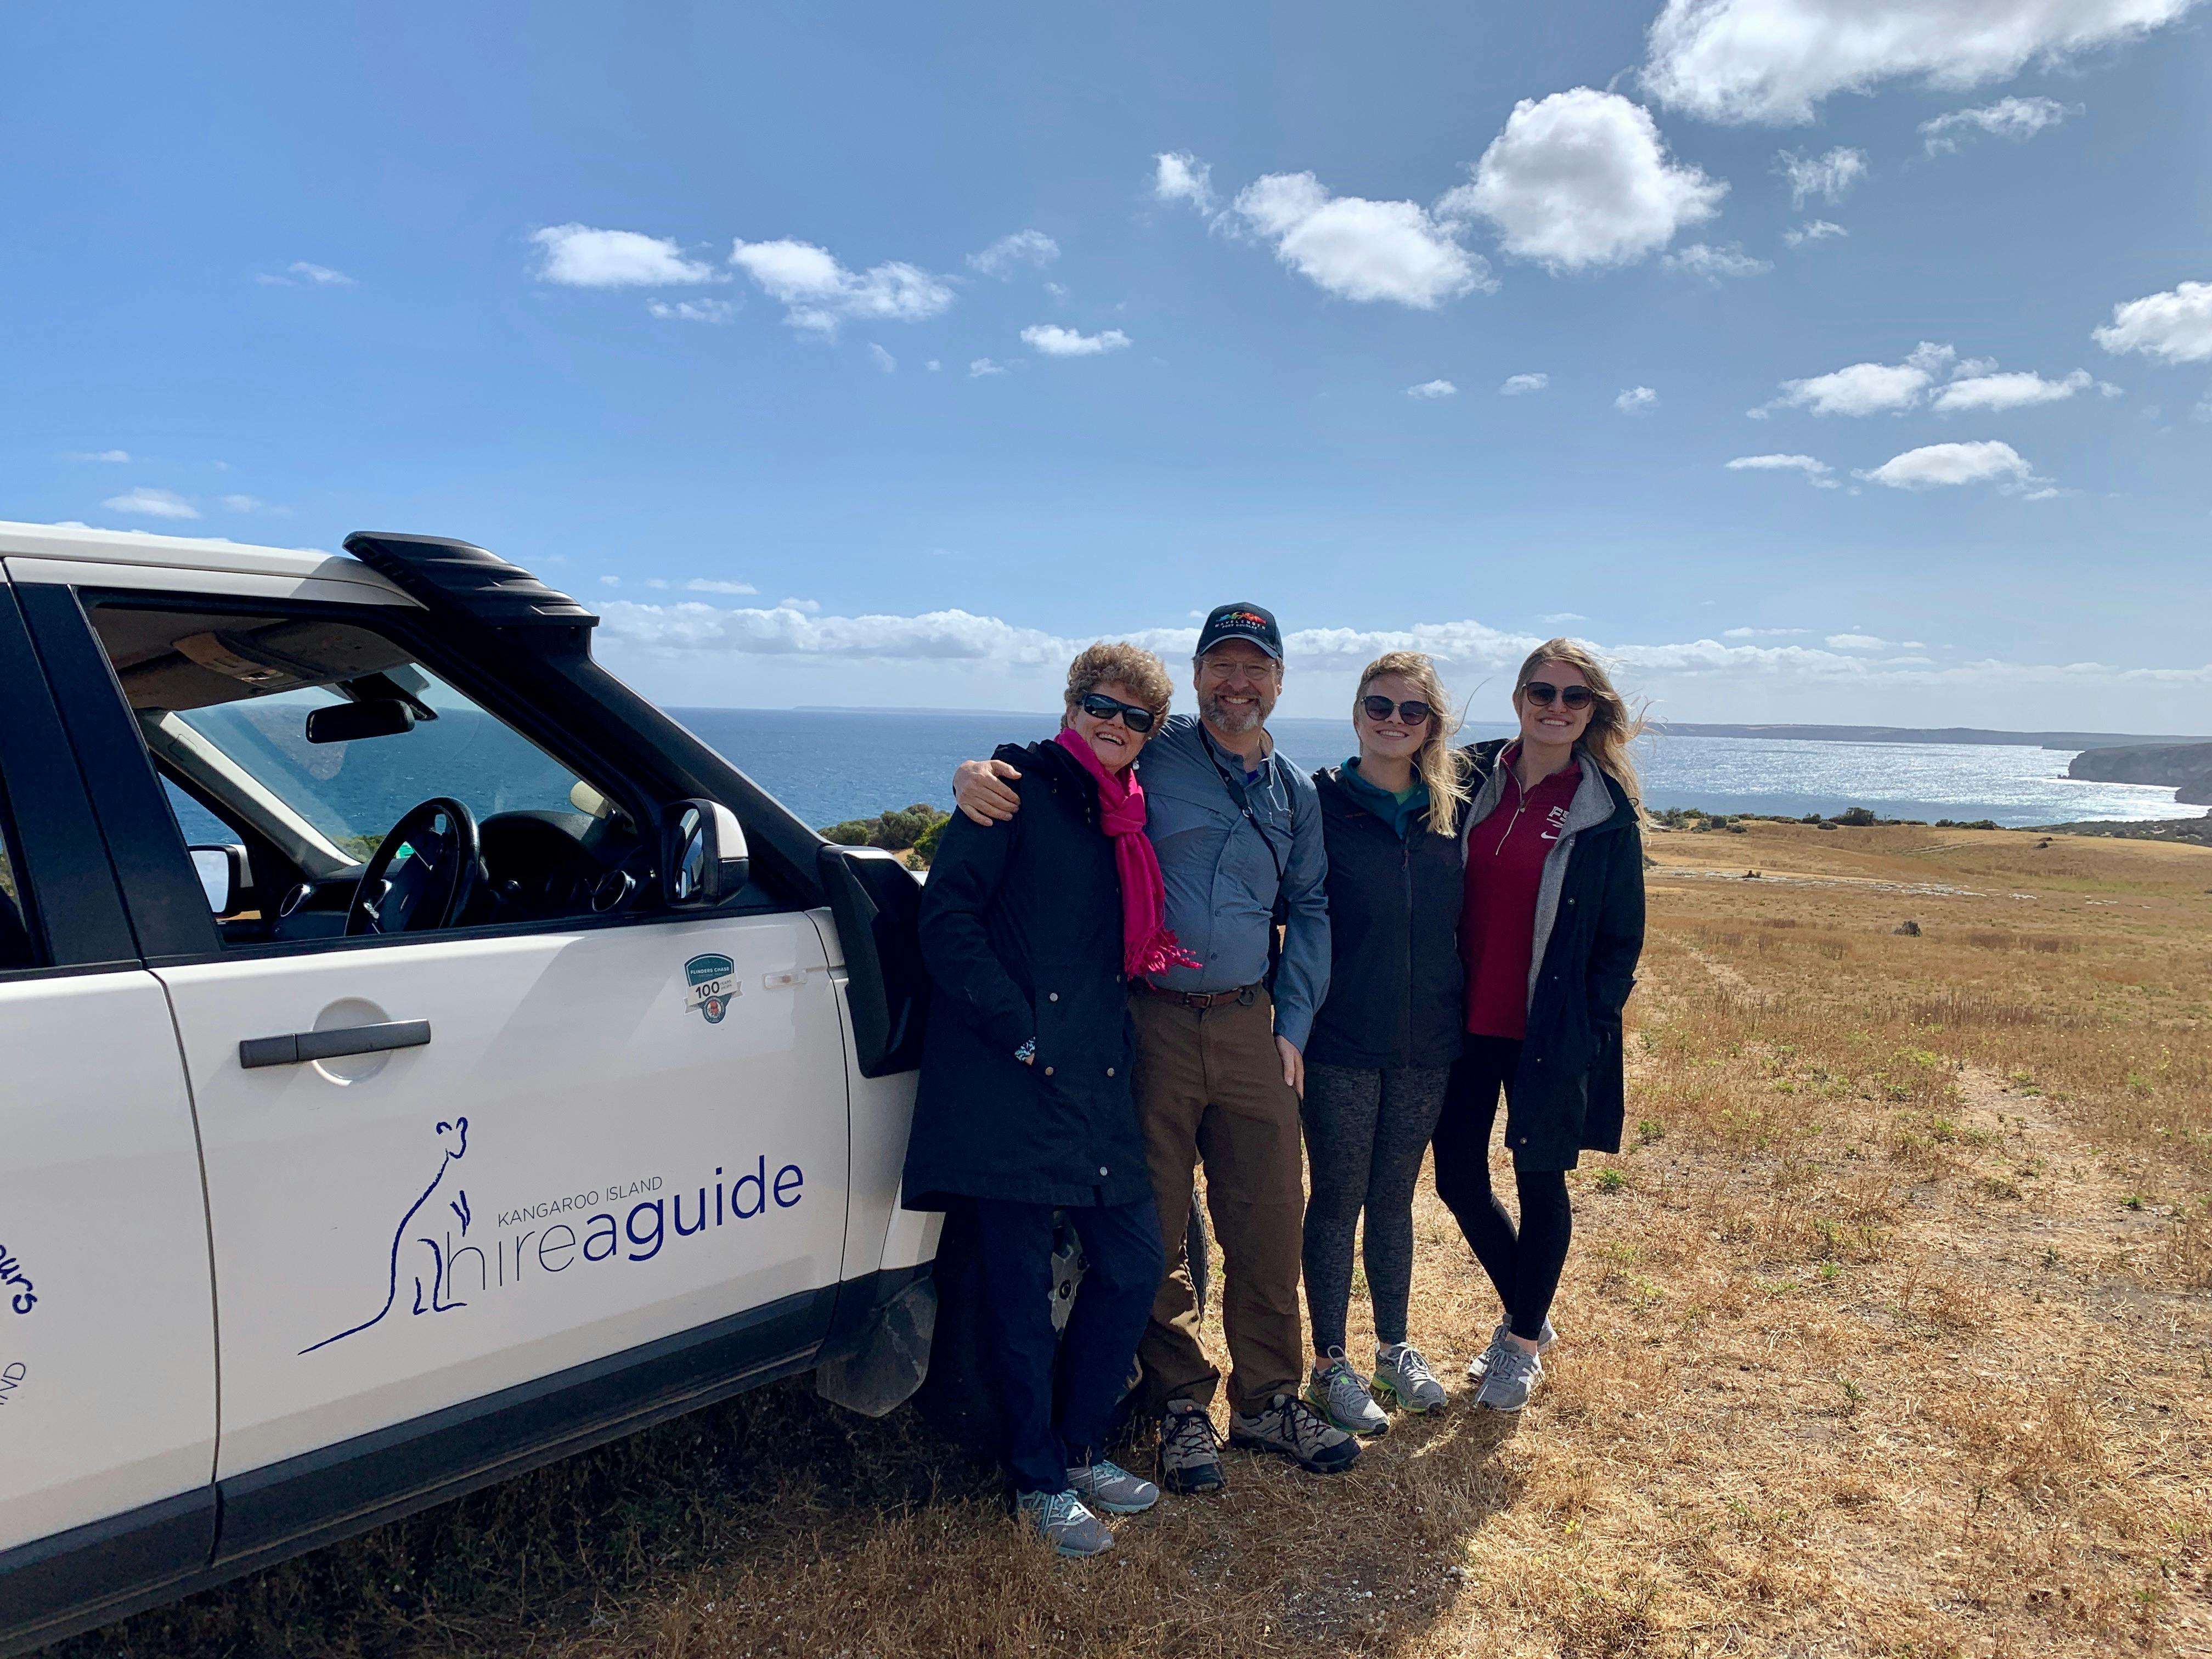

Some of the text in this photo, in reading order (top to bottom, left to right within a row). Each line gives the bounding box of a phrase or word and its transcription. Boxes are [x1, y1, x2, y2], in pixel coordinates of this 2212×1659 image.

[695, 981, 720, 998] 100
[498, 1177, 662, 1227] KANGAROO ISLAND
